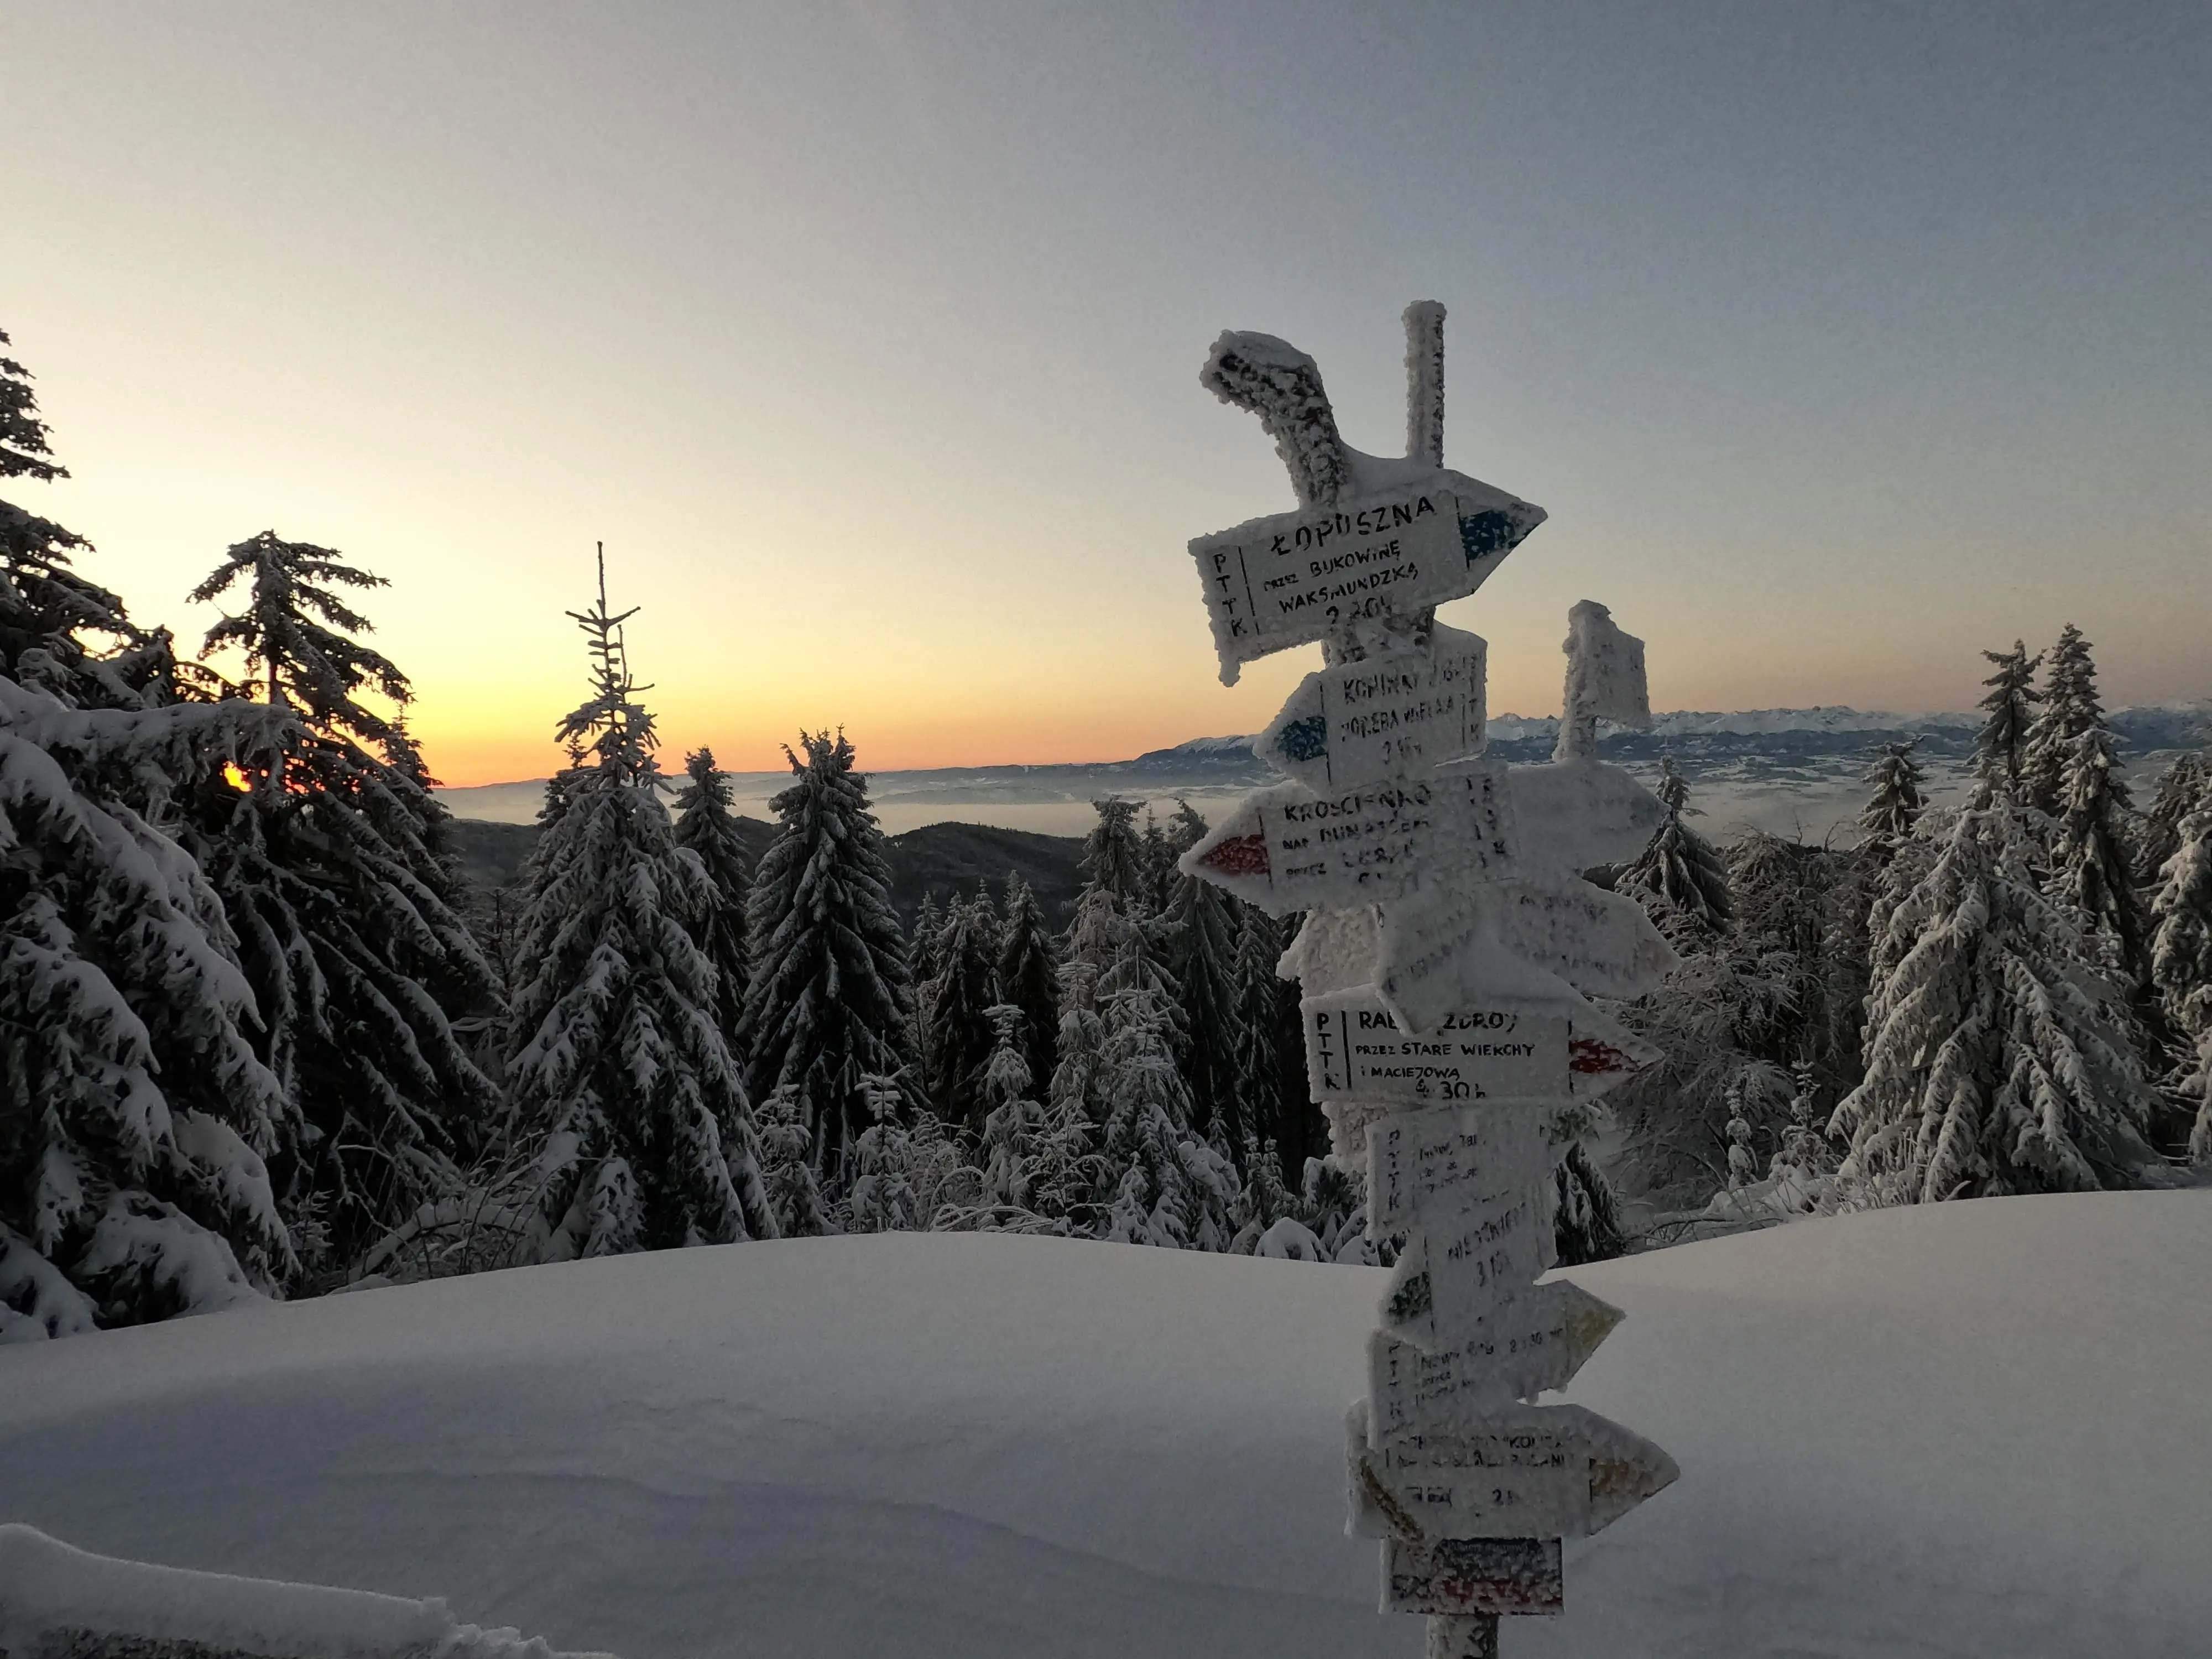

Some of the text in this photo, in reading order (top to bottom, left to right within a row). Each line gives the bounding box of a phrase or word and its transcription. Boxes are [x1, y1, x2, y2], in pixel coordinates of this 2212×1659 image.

[1271, 497, 1435, 556] ŁOPUSZNA
[1278, 562, 1418, 614] WAKSMUNDZKĄ
[1355, 1044, 1396, 1056] PRZEZ
[1401, 1042, 1453, 1057] STARE
